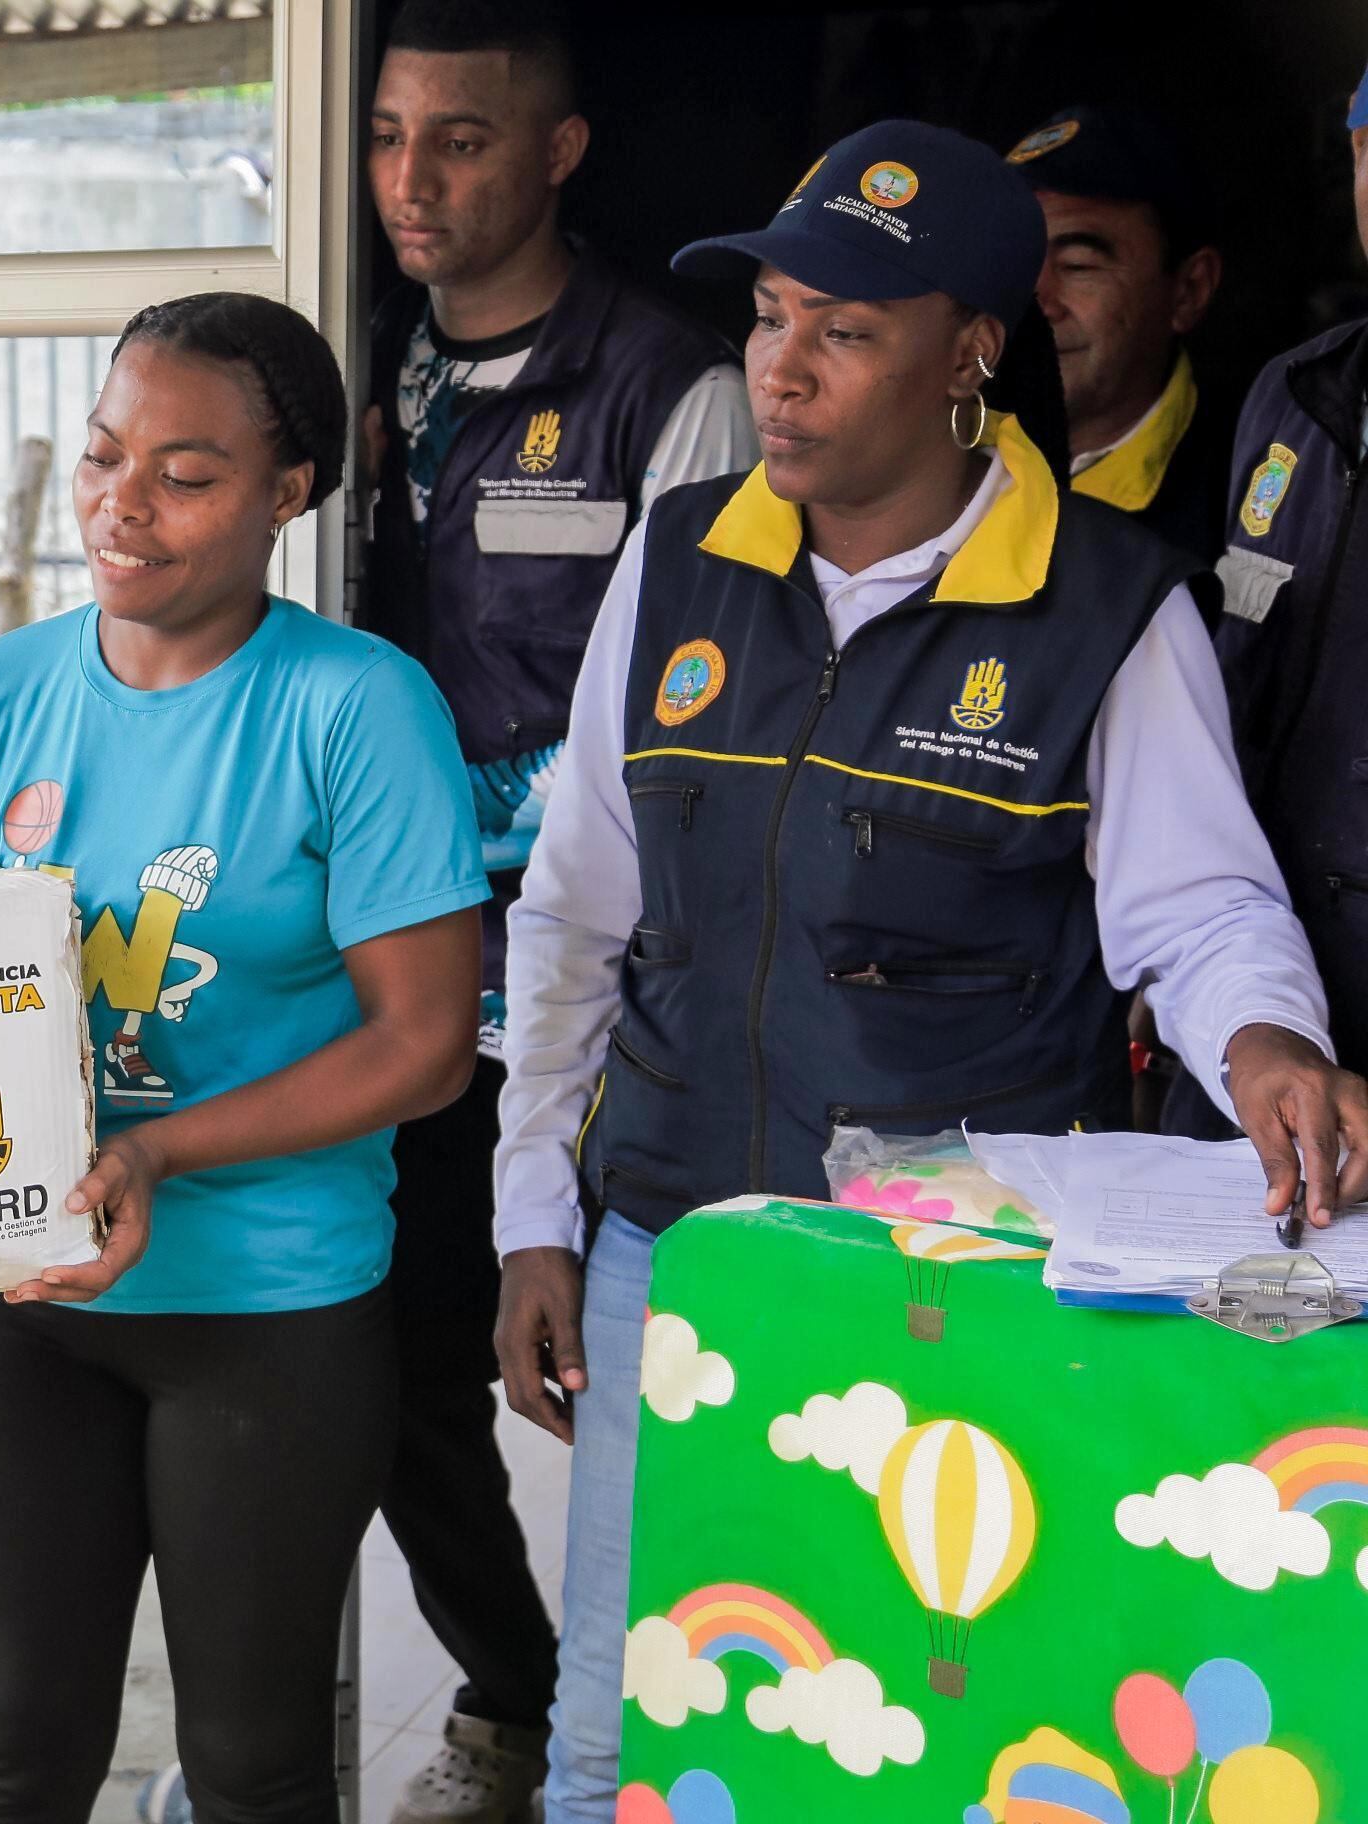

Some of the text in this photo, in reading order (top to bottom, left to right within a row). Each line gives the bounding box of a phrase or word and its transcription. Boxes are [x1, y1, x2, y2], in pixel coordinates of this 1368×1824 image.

[823, 201, 869, 221] CARTAGENA
[870, 216, 884, 227] DE
[883, 223, 912, 243] INDIAS
[835, 195, 909, 232] ALCALDÍA MAYOR
[895, 726, 1039, 760] Sistema Nacional de Gestión
[900, 739, 1026, 772] del Riesgo de Desastres
[4, 1218, 35, 1231] Gestión
[36, 1216, 47, 1225] del
[7, 1226, 47, 1239] Cartagena
